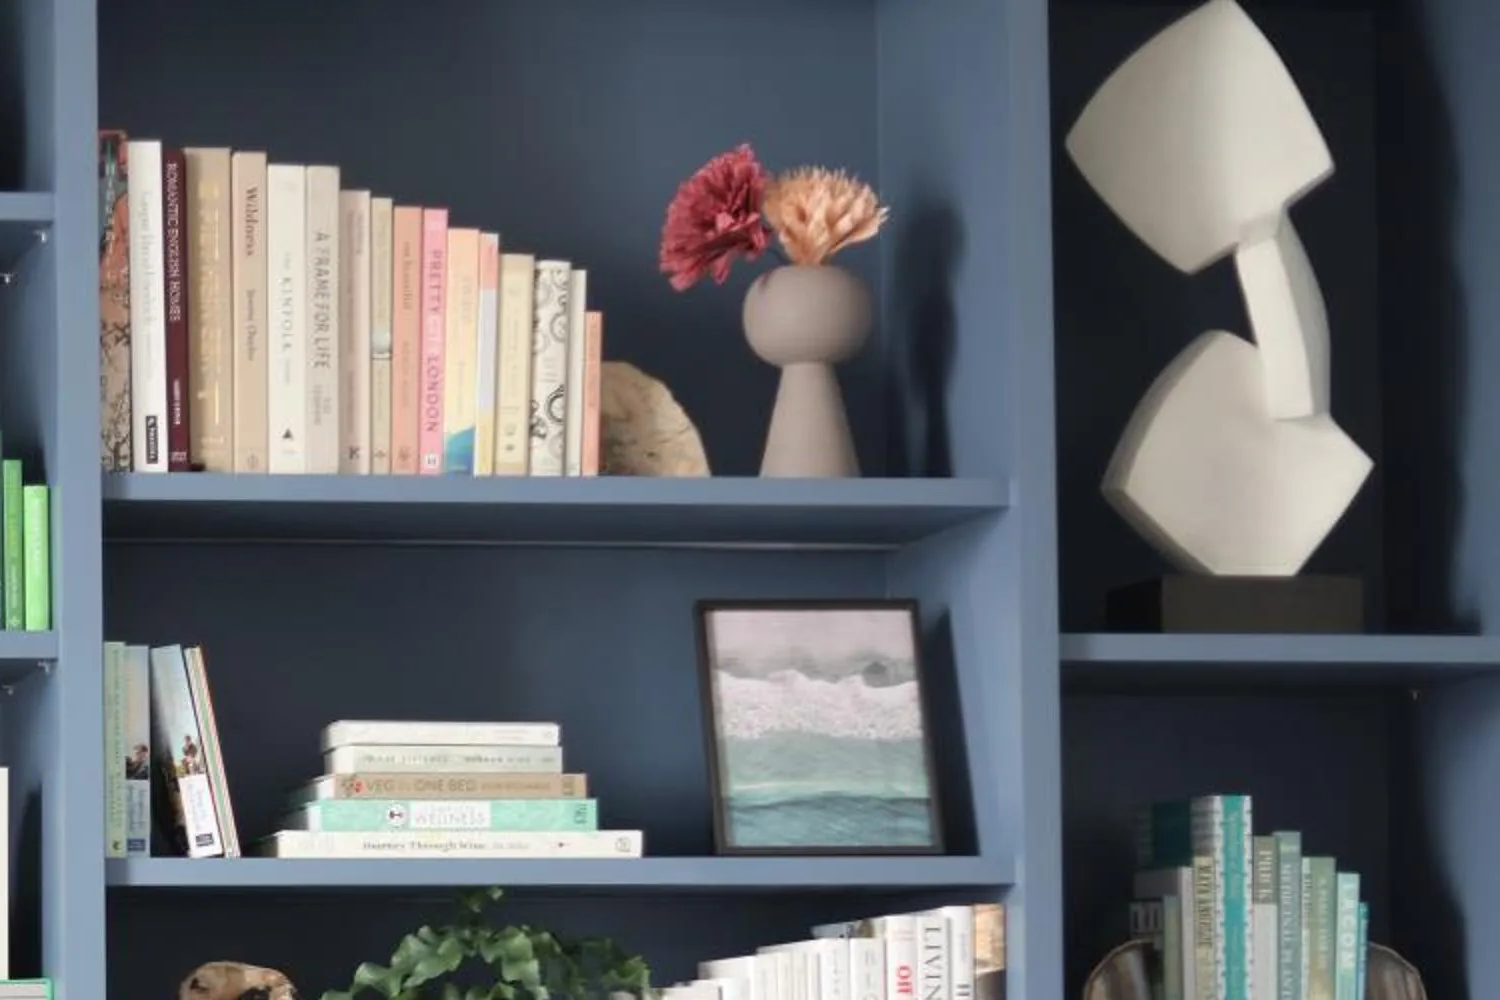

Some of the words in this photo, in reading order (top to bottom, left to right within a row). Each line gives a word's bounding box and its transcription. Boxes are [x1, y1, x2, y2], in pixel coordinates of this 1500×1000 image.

[166, 162, 179, 226] ROMANTIC
[244, 187, 259, 257] Wildness
[316, 232, 329, 241] A
[167, 229, 180, 277] ENGLISH
[315, 248, 330, 300] FRAME
[168, 281, 181, 321] HOMES
[428, 248, 441, 314] PRETTY
[315, 303, 330, 331] FOR
[314, 337, 331, 369] LIFE
[426, 355, 439, 433] LONDON
[897, 965, 913, 995] Off
